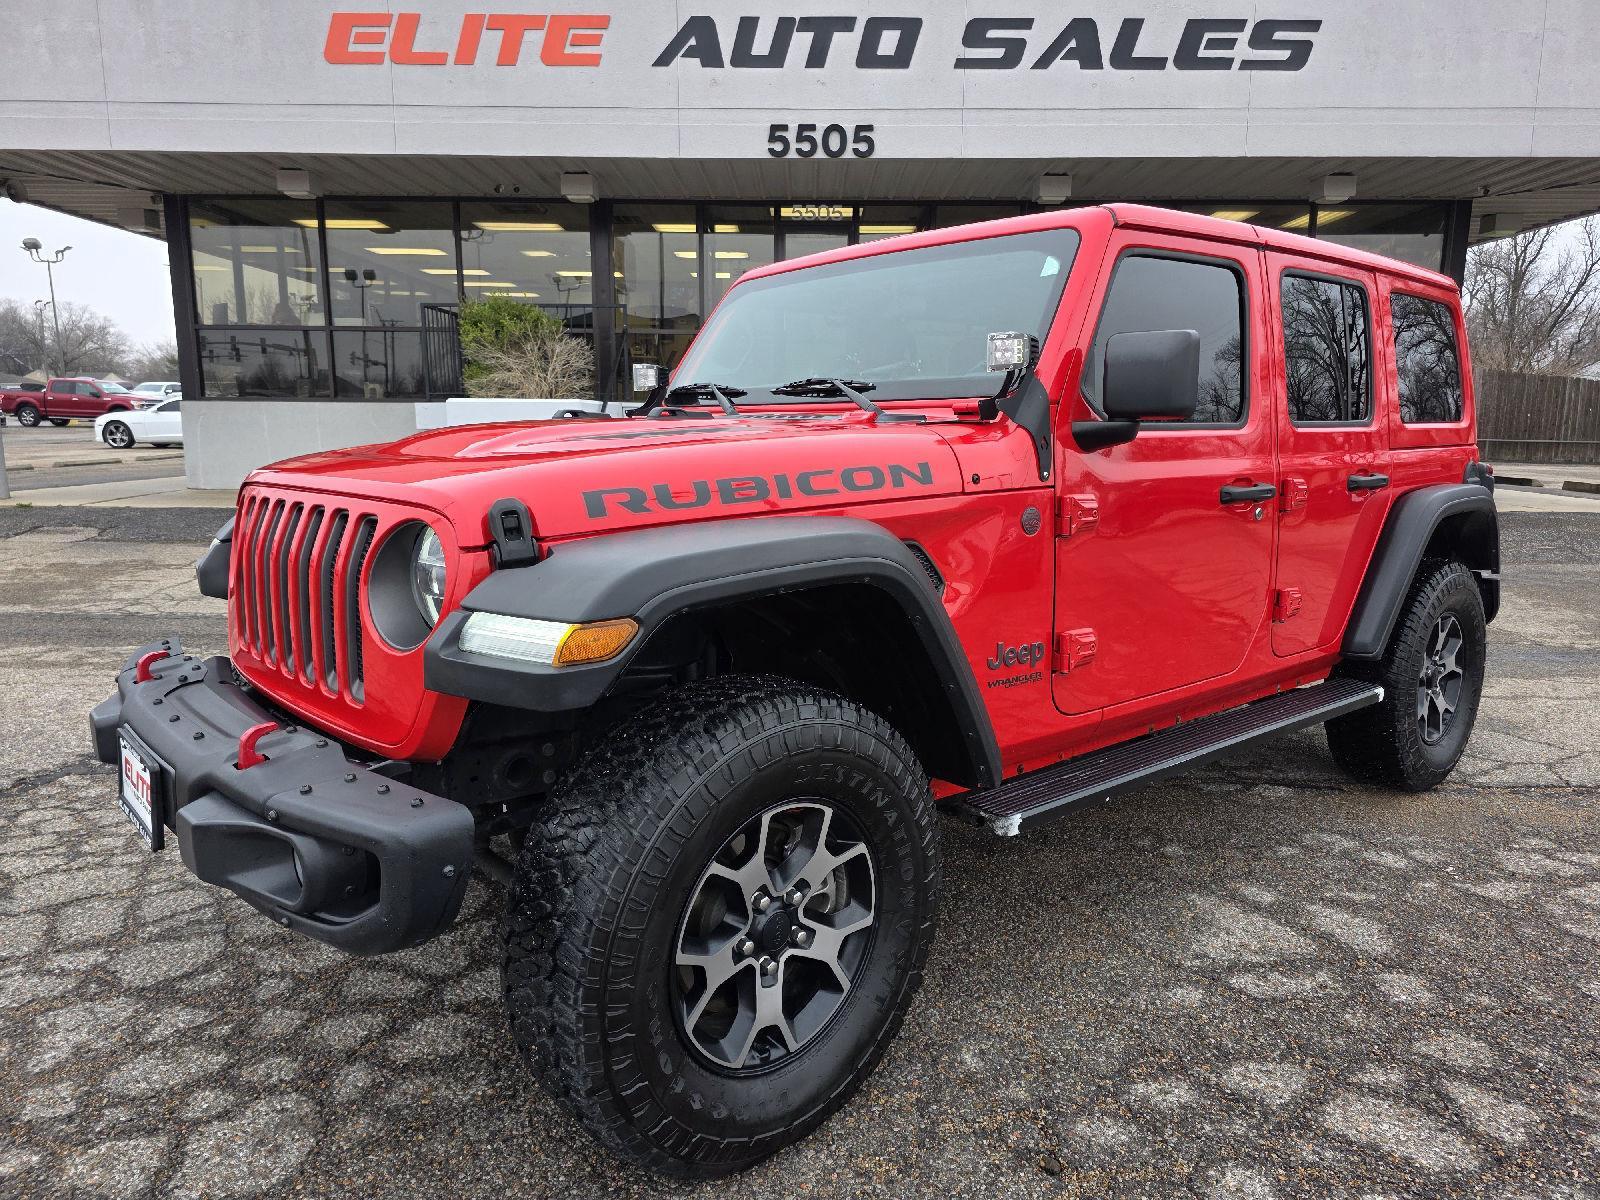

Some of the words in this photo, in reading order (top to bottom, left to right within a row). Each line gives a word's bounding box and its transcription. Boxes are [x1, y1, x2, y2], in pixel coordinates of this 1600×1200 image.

[323, 12, 611, 67] ELITE
[651, 15, 923, 69] AUTO
[954, 17, 1323, 71] SALES
[767, 123, 876, 159] 5505
[791, 204, 843, 221] 5505
[582, 462, 934, 519] RUBICON
[987, 641, 1045, 671] Jeep
[987, 671, 1043, 688] WRANGLER
